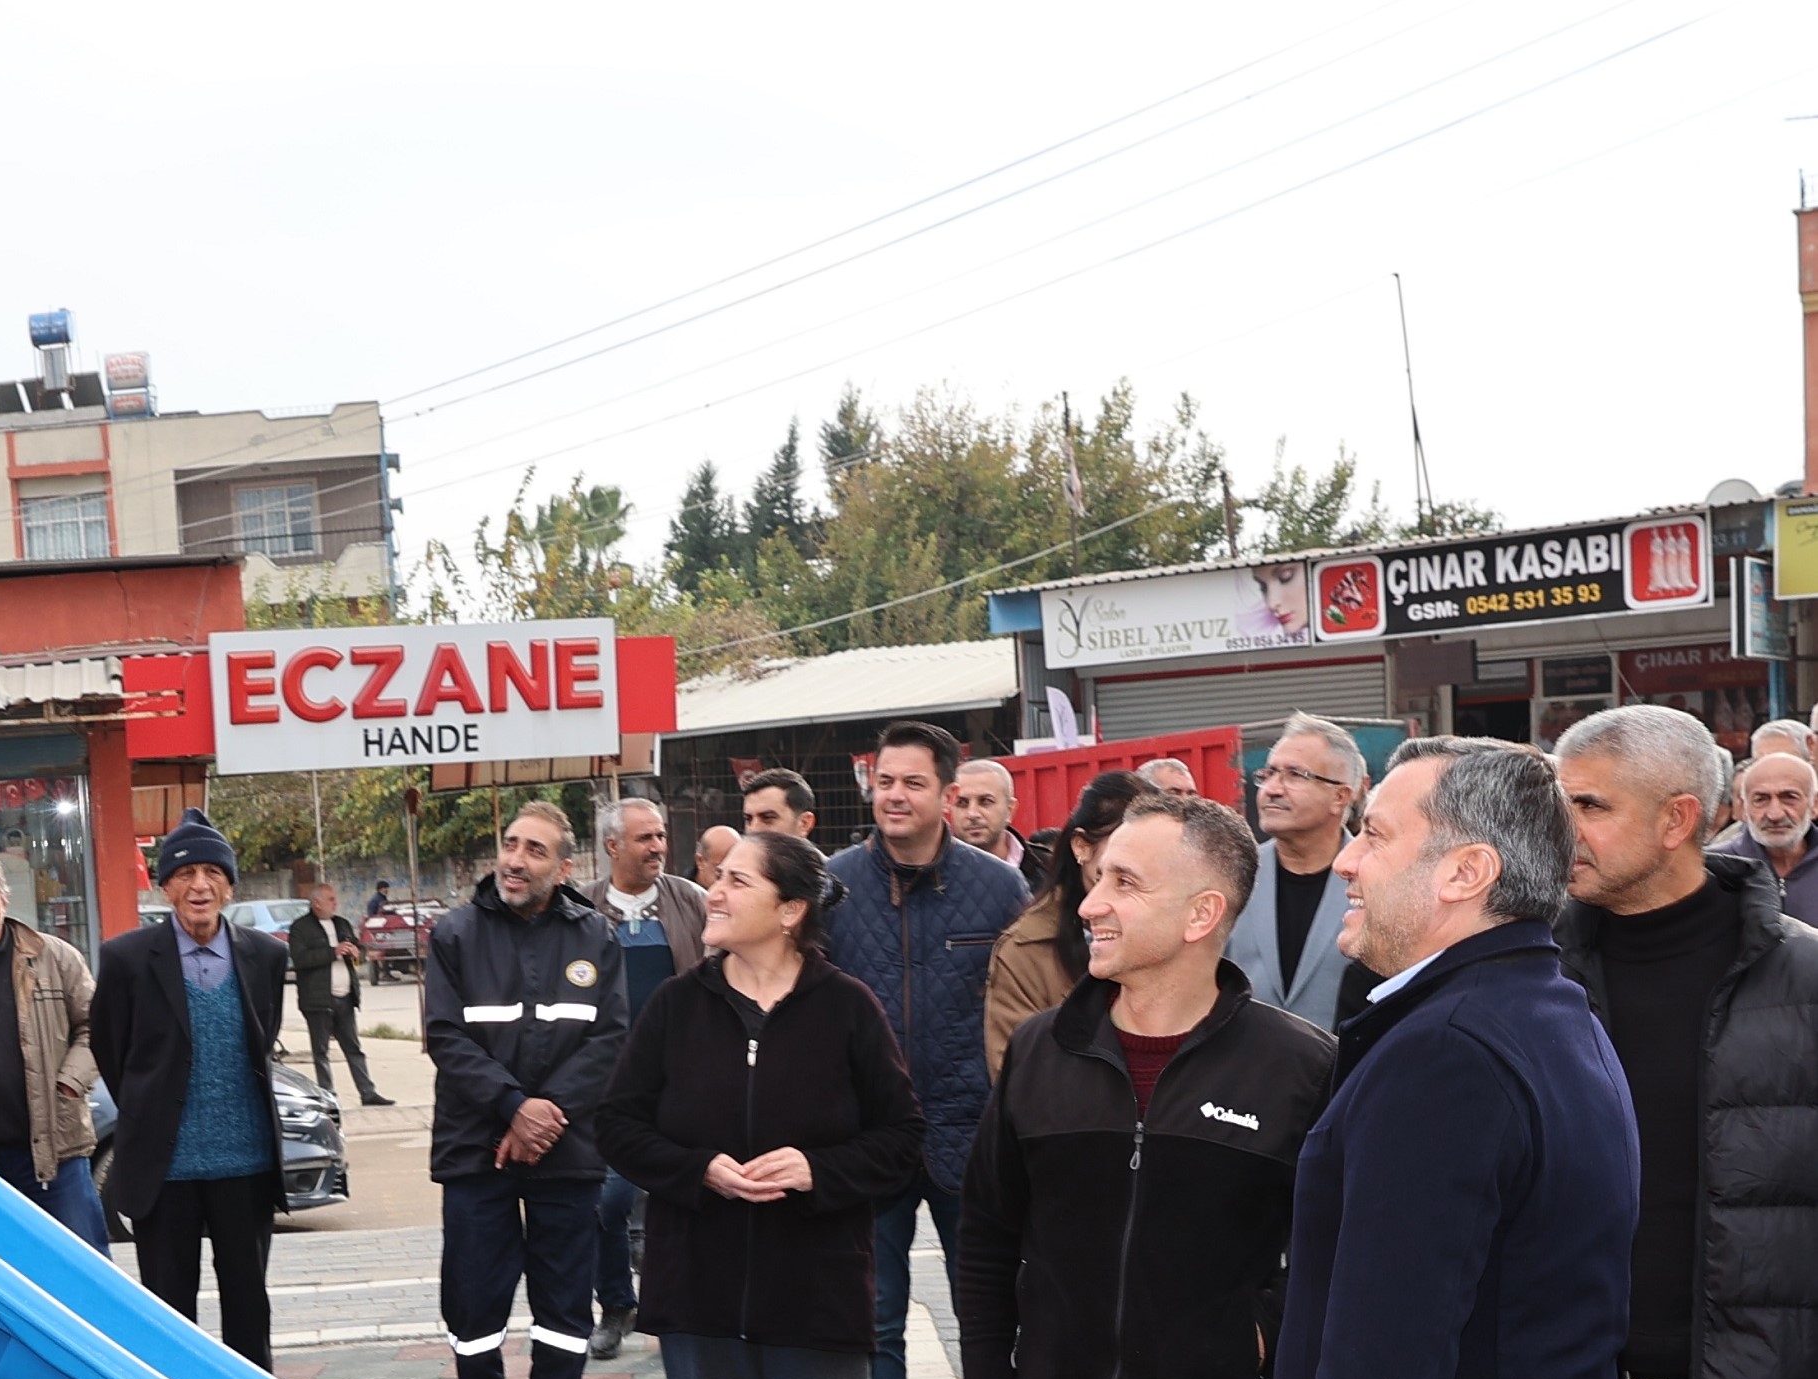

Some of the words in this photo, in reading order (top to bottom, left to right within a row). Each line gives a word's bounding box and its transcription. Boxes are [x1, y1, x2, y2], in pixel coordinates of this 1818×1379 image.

[1386, 549, 1488, 606] ÇINAR
[1495, 532, 1622, 584] KASABI
[1407, 600, 1460, 622] GSM:
[1466, 593, 1510, 615] 0542
[1513, 589, 1545, 610] 531
[1550, 586, 1574, 607] 35
[1577, 583, 1602, 603] 93
[1087, 626, 1150, 651] SİBEL
[1154, 618, 1230, 644] YAVUZ
[1634, 649, 1703, 672] ÇINAR
[226, 637, 604, 726] ECZANE
[363, 723, 480, 758] HANDE
